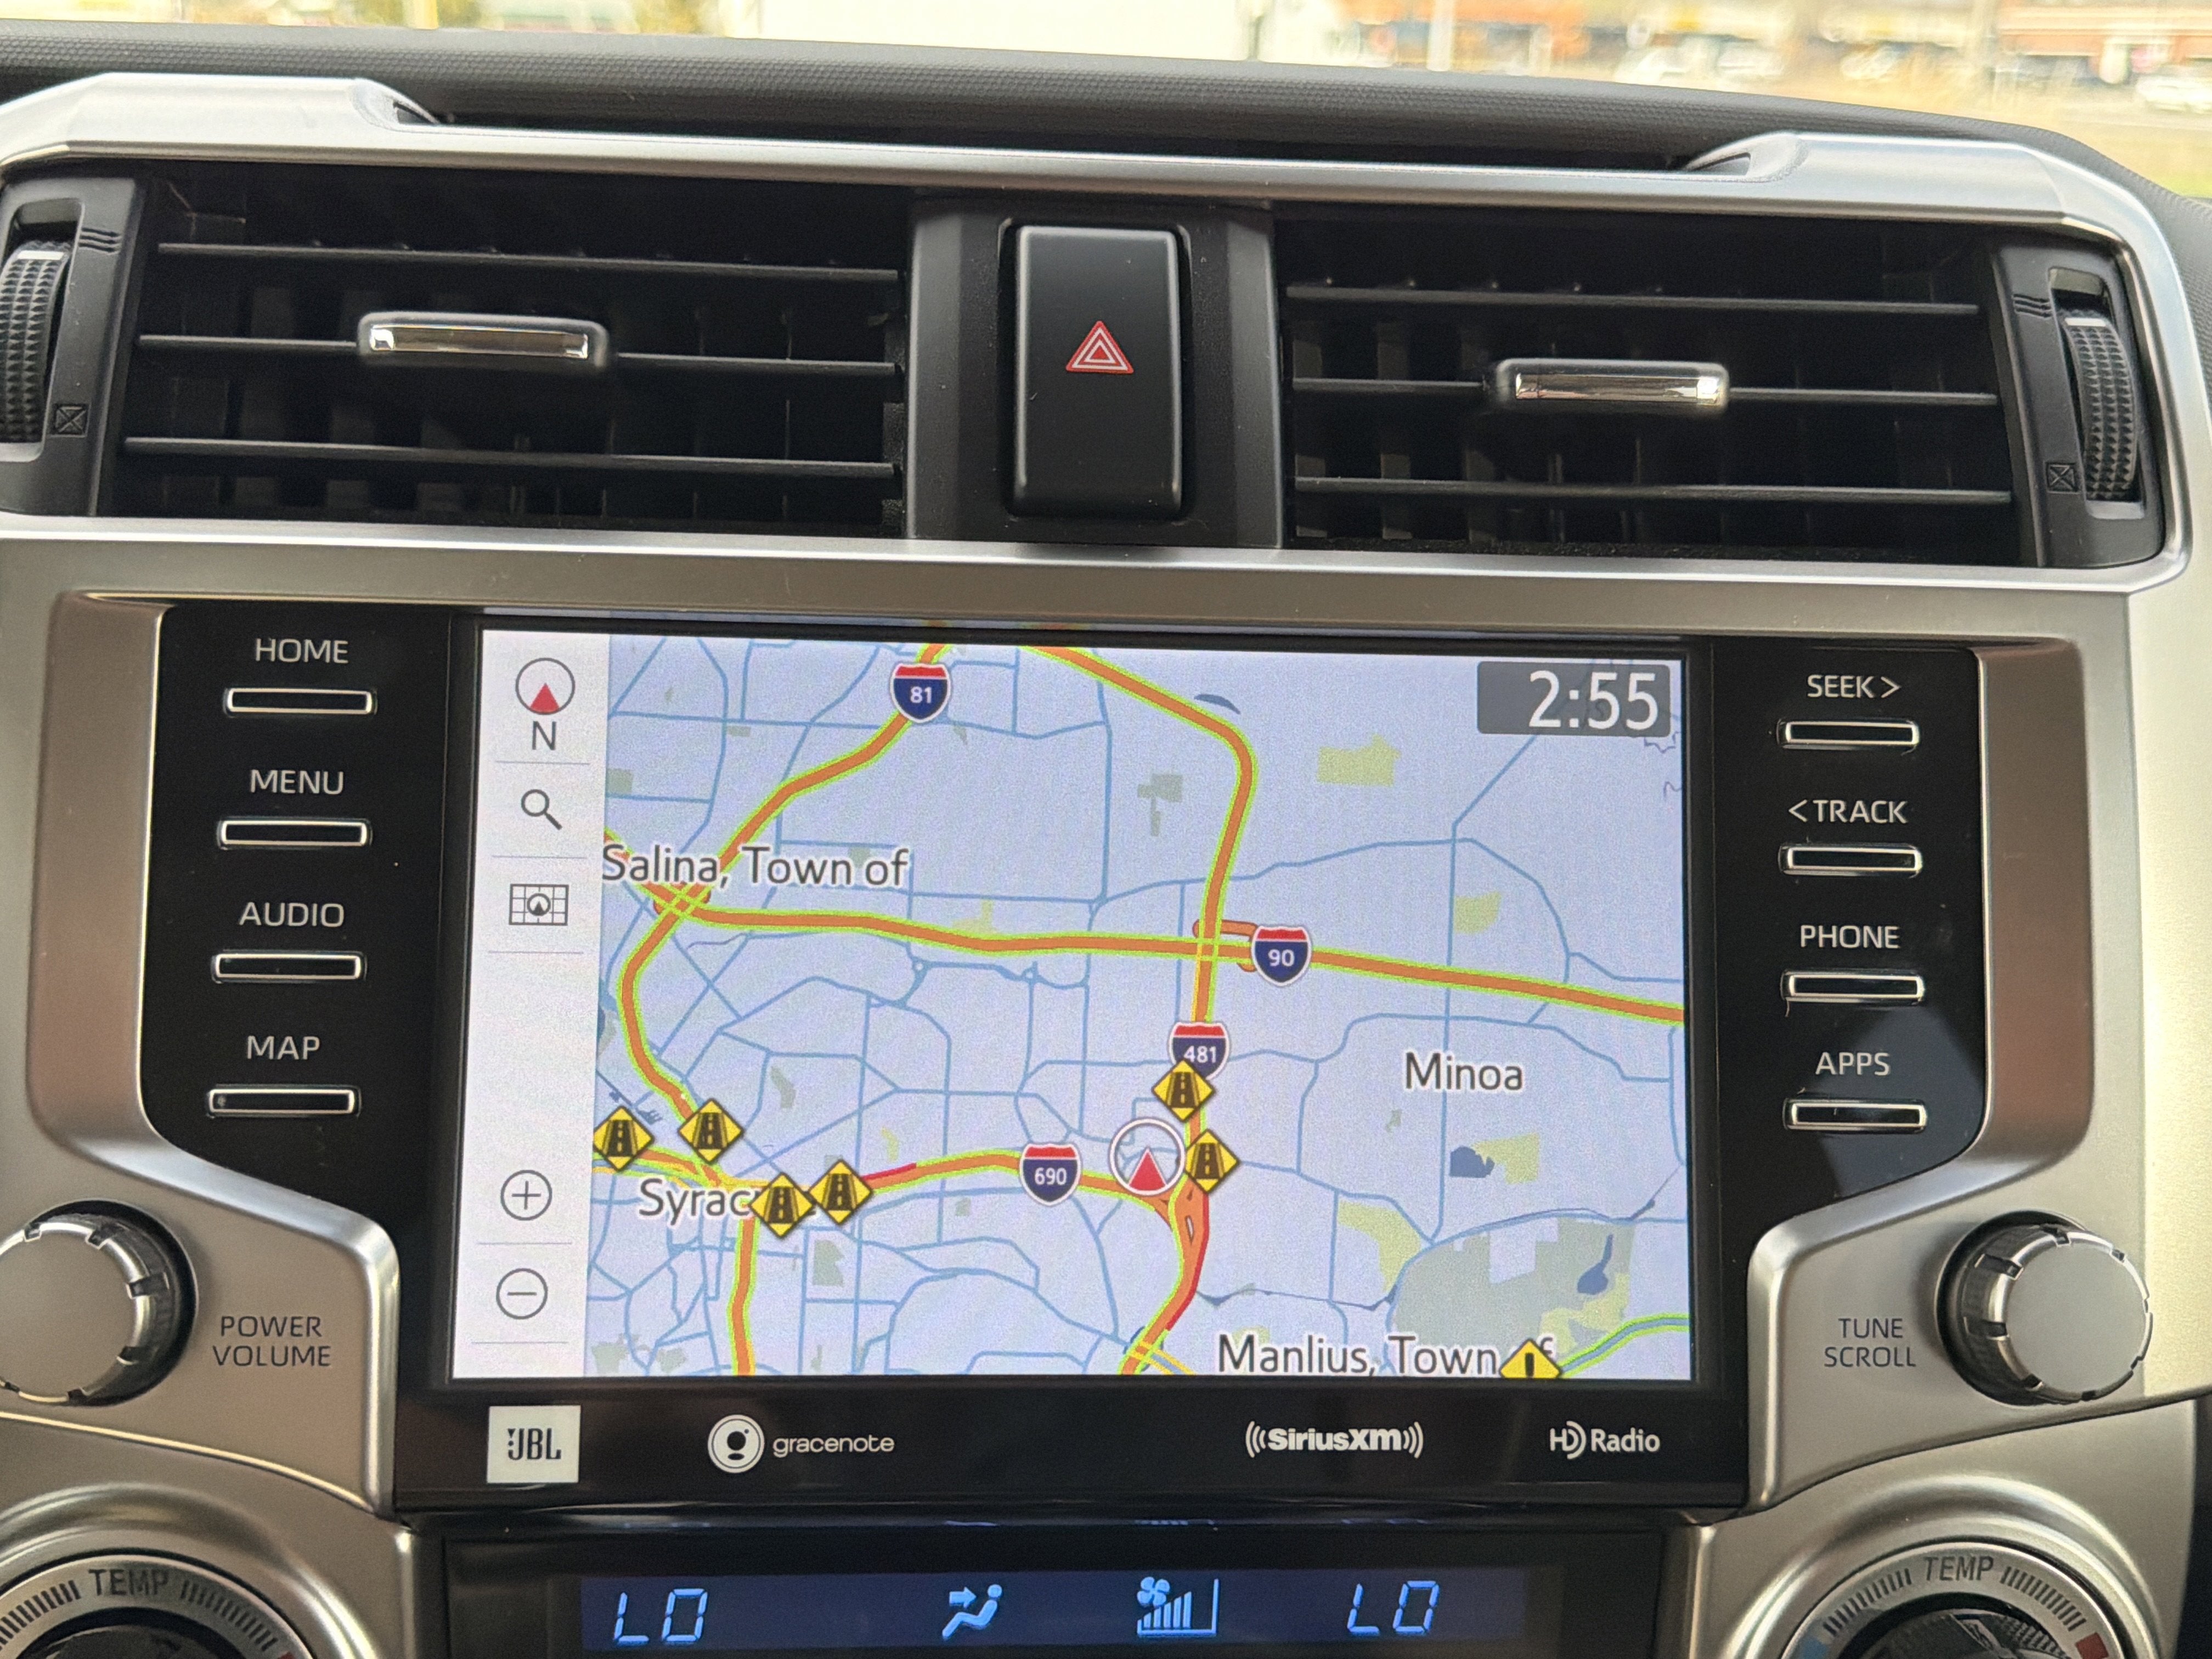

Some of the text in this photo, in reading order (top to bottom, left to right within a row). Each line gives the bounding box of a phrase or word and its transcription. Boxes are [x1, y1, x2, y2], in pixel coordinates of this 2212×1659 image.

[255, 637, 349, 664] HOME
[910, 687, 932, 704] 81
[1528, 670, 1659, 730] 2:55
[531, 721, 557, 751] N
[250, 769, 344, 795] MENU
[603, 845, 910, 888] Salina, Town of
[239, 902, 345, 927] AUDIO
[1801, 925, 1899, 949] PHONE
[1267, 950, 1295, 967] 90
[246, 1036, 320, 1060] MAP
[1184, 1046, 1216, 1063] 481
[1404, 1052, 1523, 1092] Minoa
[1815, 1052, 1890, 1075] APPS
[1034, 1166, 1067, 1186] 690
[220, 1317, 322, 1338] POWER
[1838, 1318, 1904, 1339] TUNE
[213, 1345, 331, 1367] VOLUME
[1218, 1334, 1378, 1376] Manlius,
[1388, 1335, 1497, 1374] Town
[1824, 1346, 1916, 1368] SCROLL
[507, 1427, 561, 1460] JBL
[773, 1435, 895, 1458] gracenote
[1591, 1427, 1660, 1452] Radio
[1925, 1556, 1994, 1581] TEMP
[89, 1568, 170, 1595] TEMP
